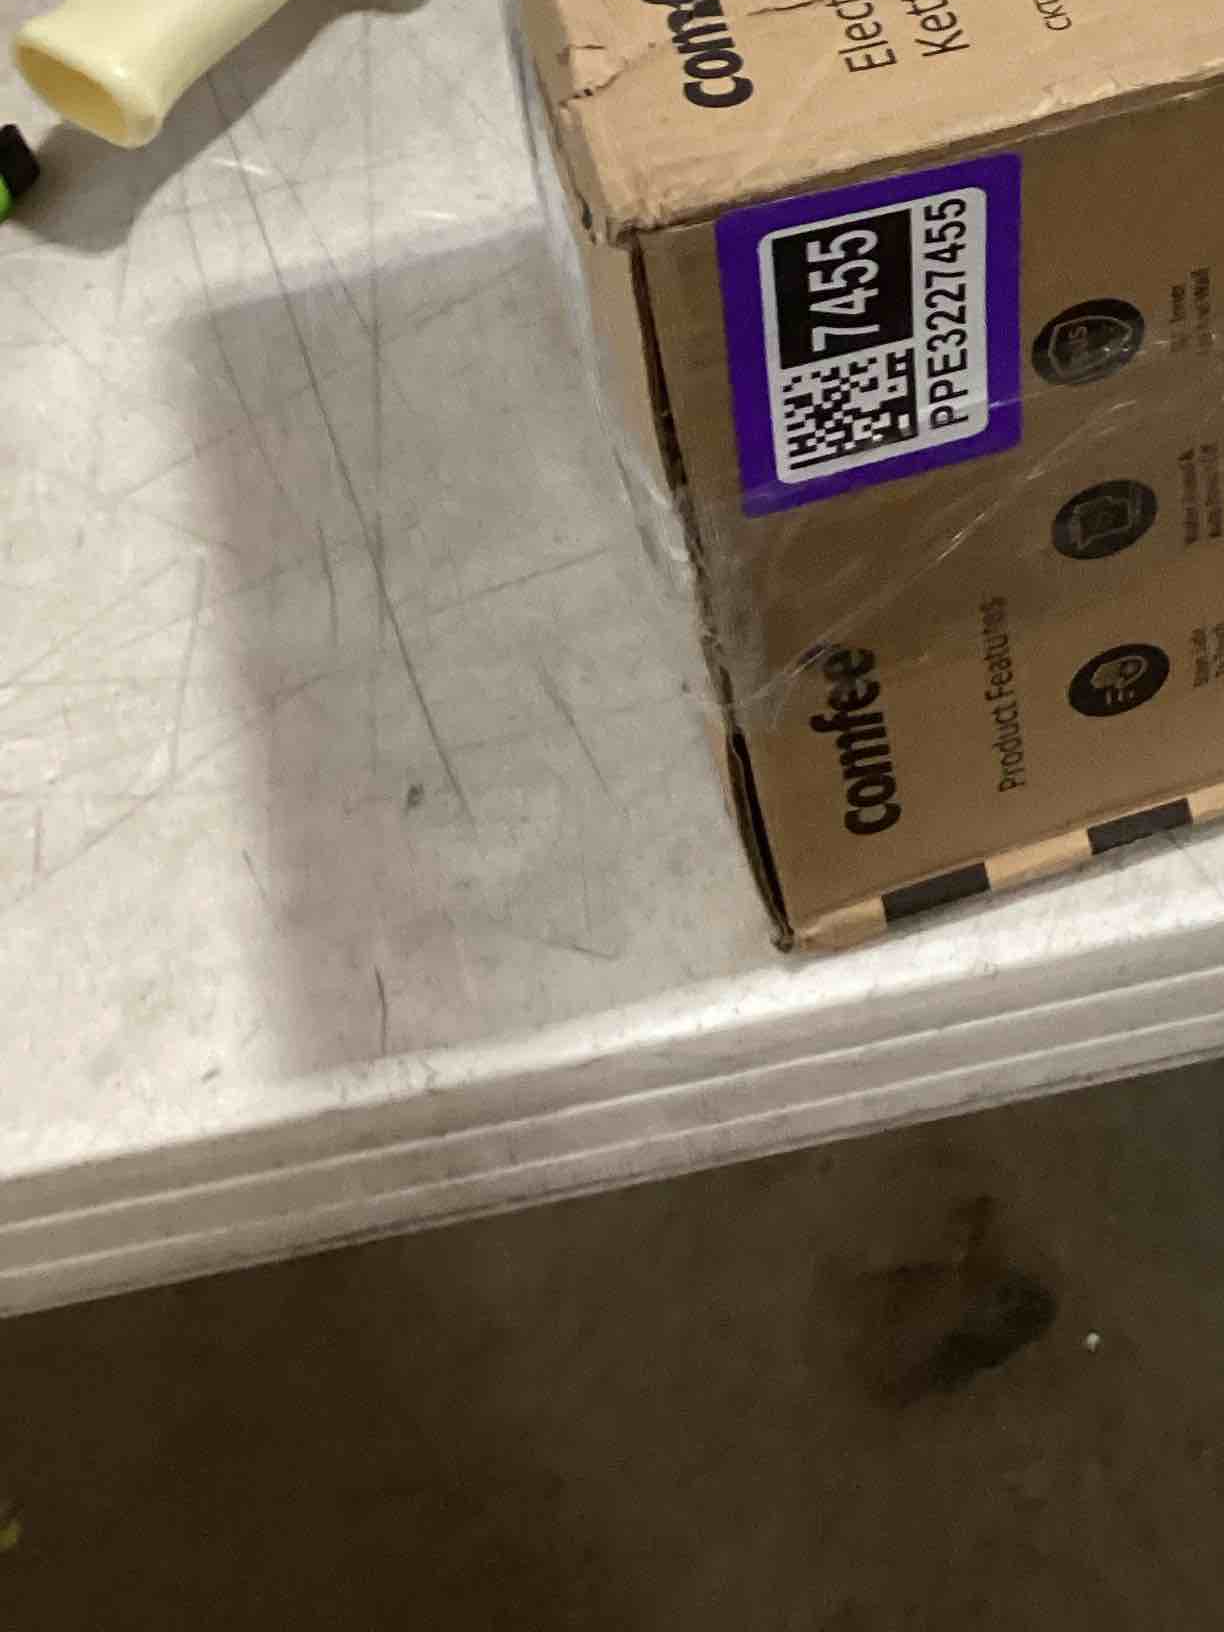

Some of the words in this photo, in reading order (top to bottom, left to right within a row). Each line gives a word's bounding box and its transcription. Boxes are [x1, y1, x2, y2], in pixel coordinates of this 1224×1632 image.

[805, 228, 881, 353] 7455
[923, 197, 970, 430] PPE3227455
[991, 700, 1027, 793] Product
